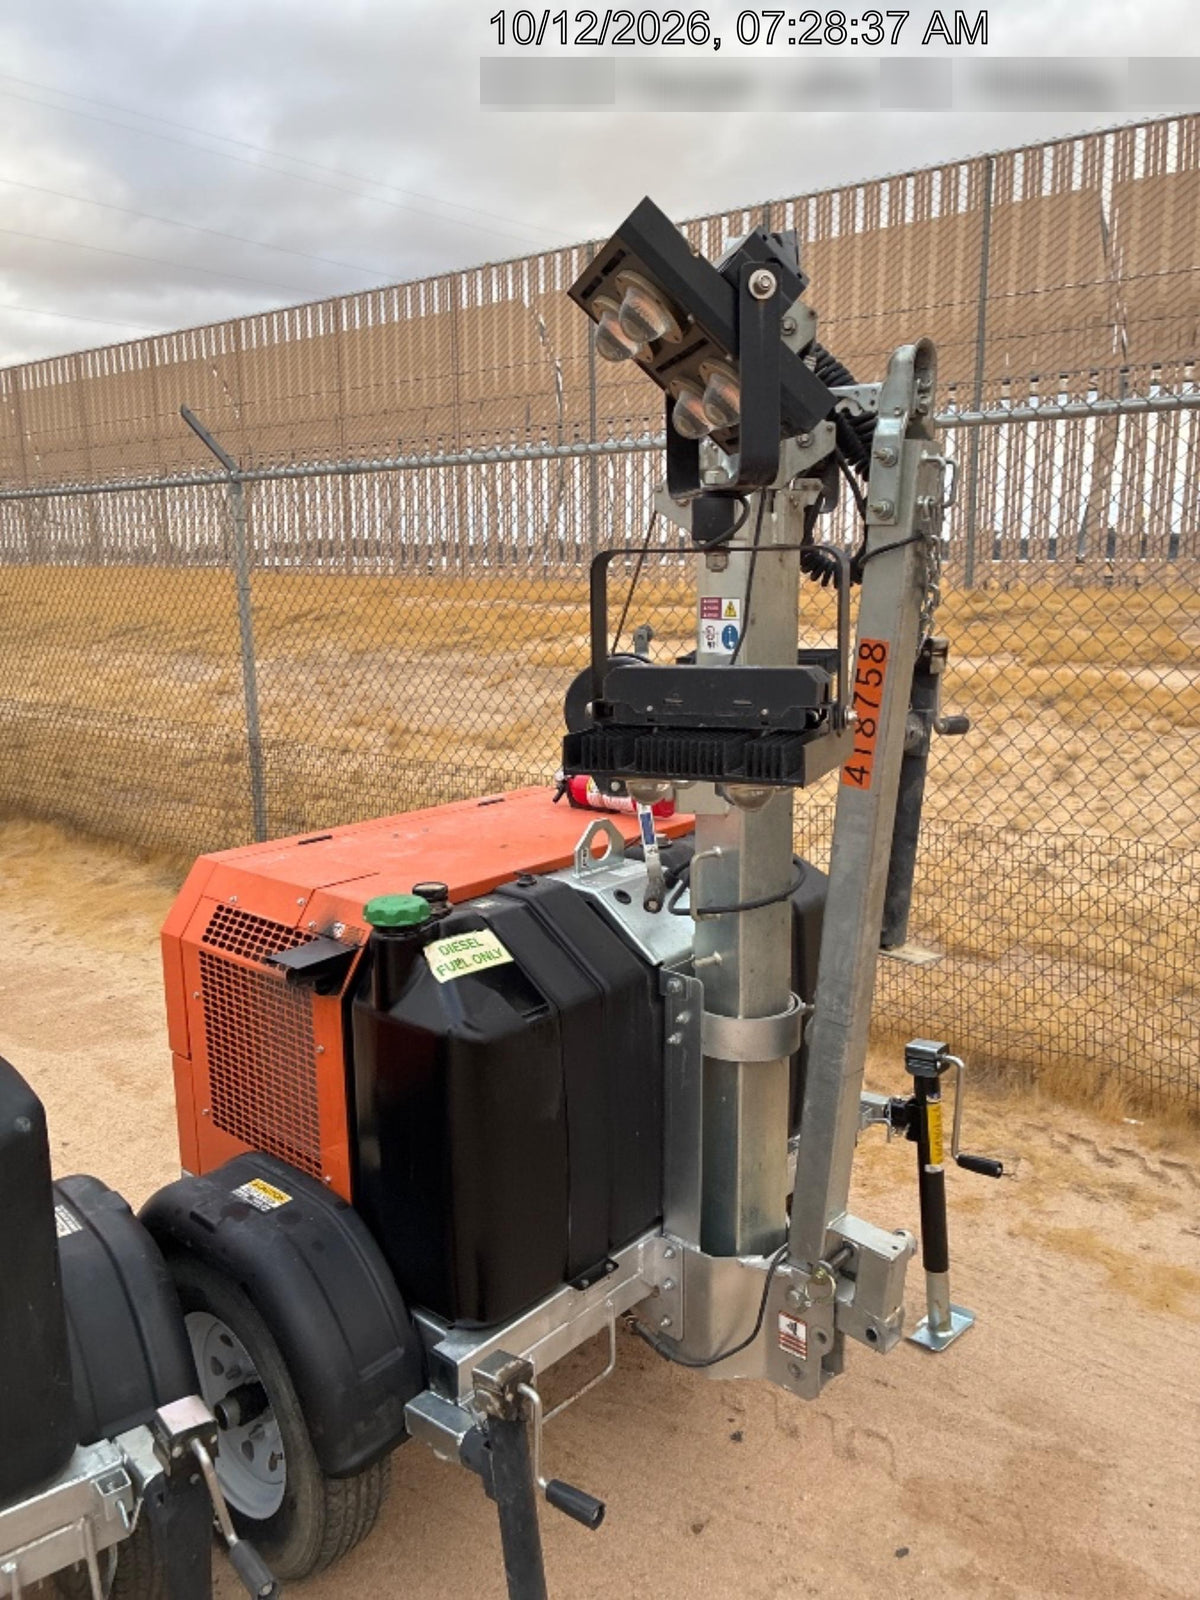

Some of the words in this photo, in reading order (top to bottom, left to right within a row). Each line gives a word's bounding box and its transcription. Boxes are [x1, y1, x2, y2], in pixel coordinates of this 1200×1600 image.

[844, 642, 887, 785] 418758
[436, 957, 472, 976] FUEL
[472, 947, 503, 965] ONLY
[438, 938, 484, 956] DIESEL
